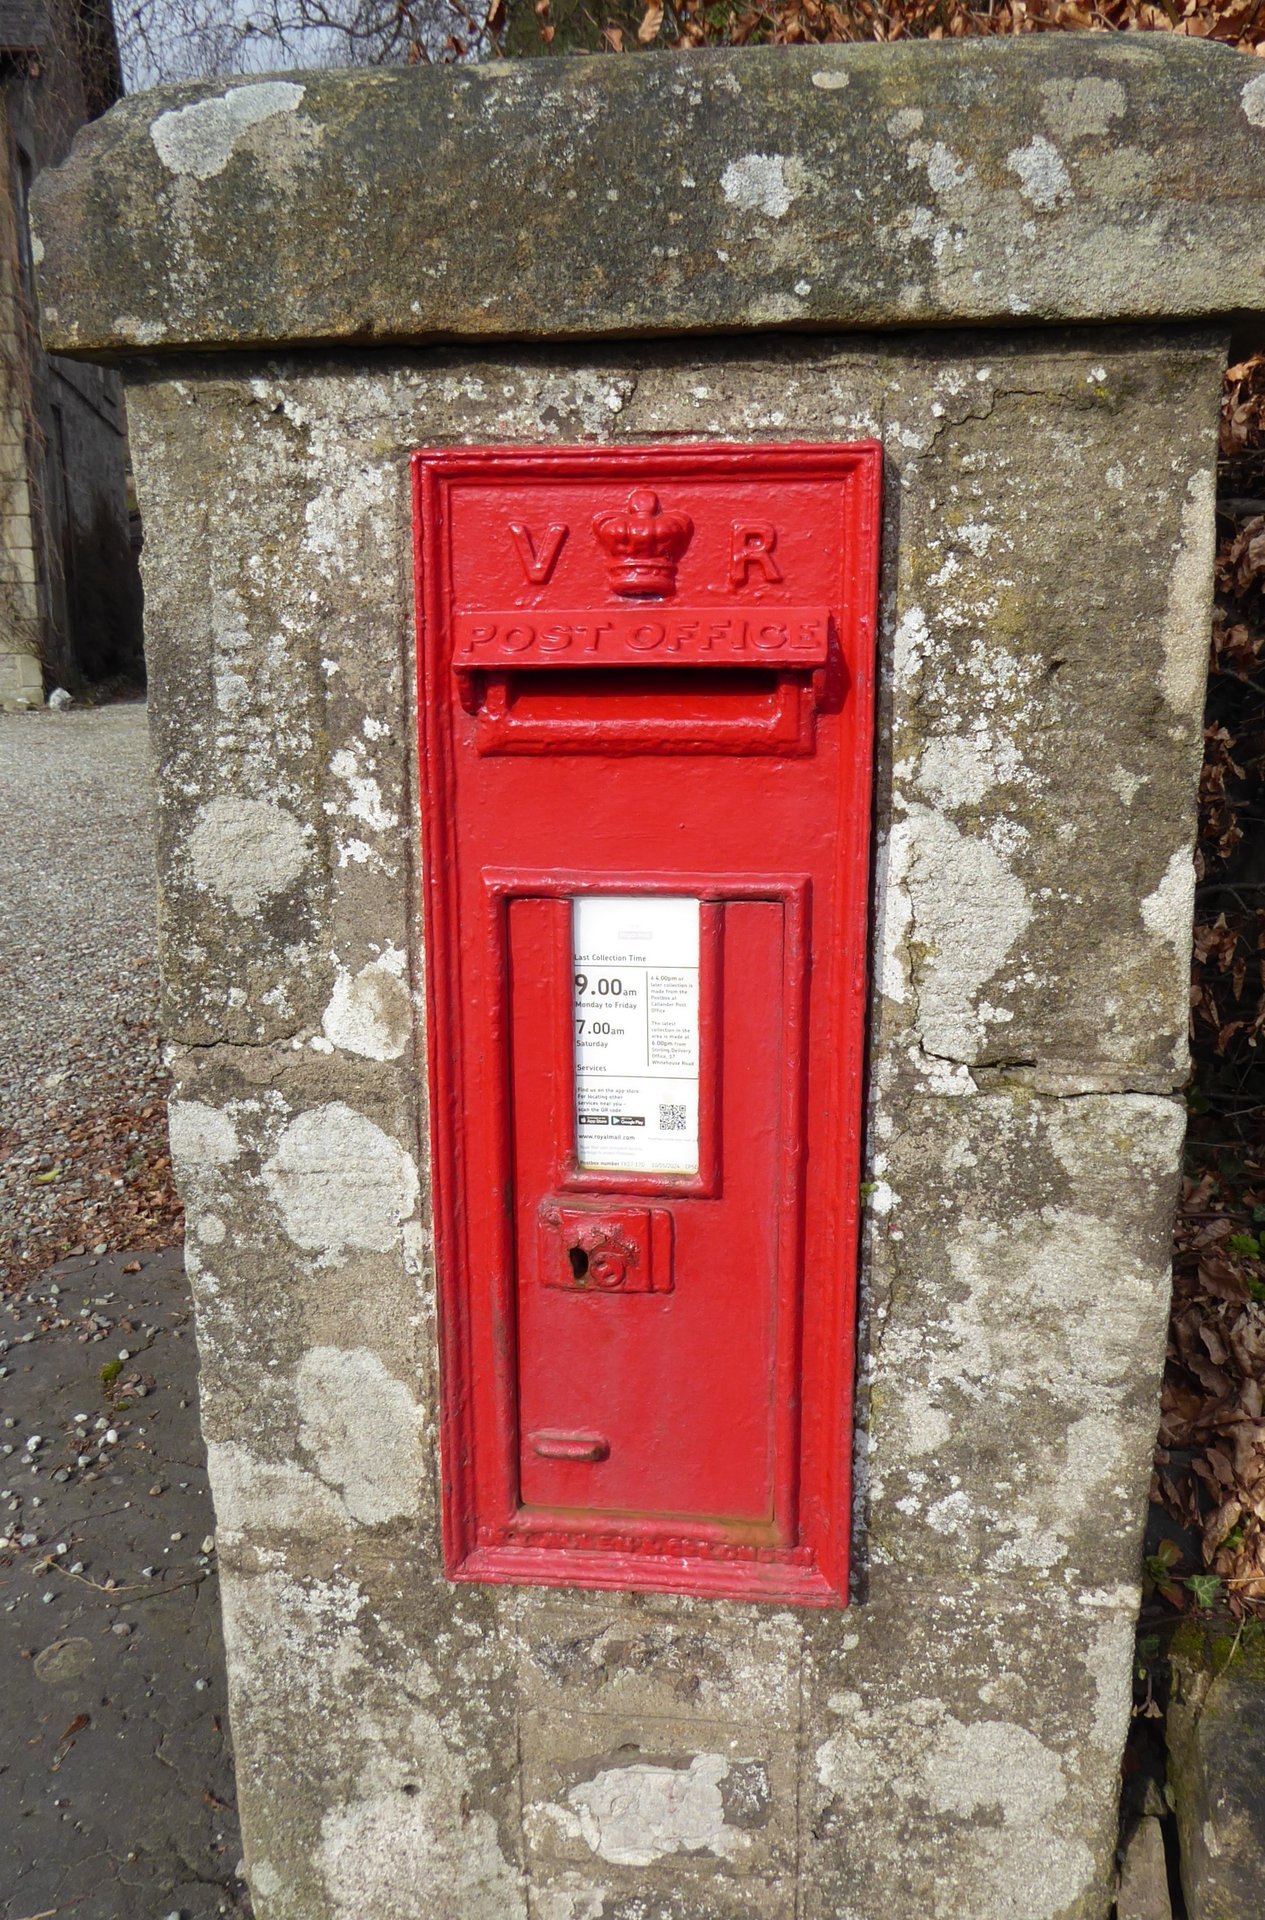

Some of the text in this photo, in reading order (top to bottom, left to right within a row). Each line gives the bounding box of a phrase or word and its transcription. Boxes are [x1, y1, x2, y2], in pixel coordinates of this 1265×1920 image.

[508, 518, 784, 587] V R
[460, 617, 822, 653] POST OFFICE
[592, 954, 627, 962] Collection
[575, 973, 637, 996] 9.00am
[575, 1001, 604, 1010] Monday
[615, 1001, 637, 1010] Friday
[576, 1019, 625, 1035] 7.00am
[576, 1040, 608, 1049] Saturday
[577, 1063, 607, 1072] Services
